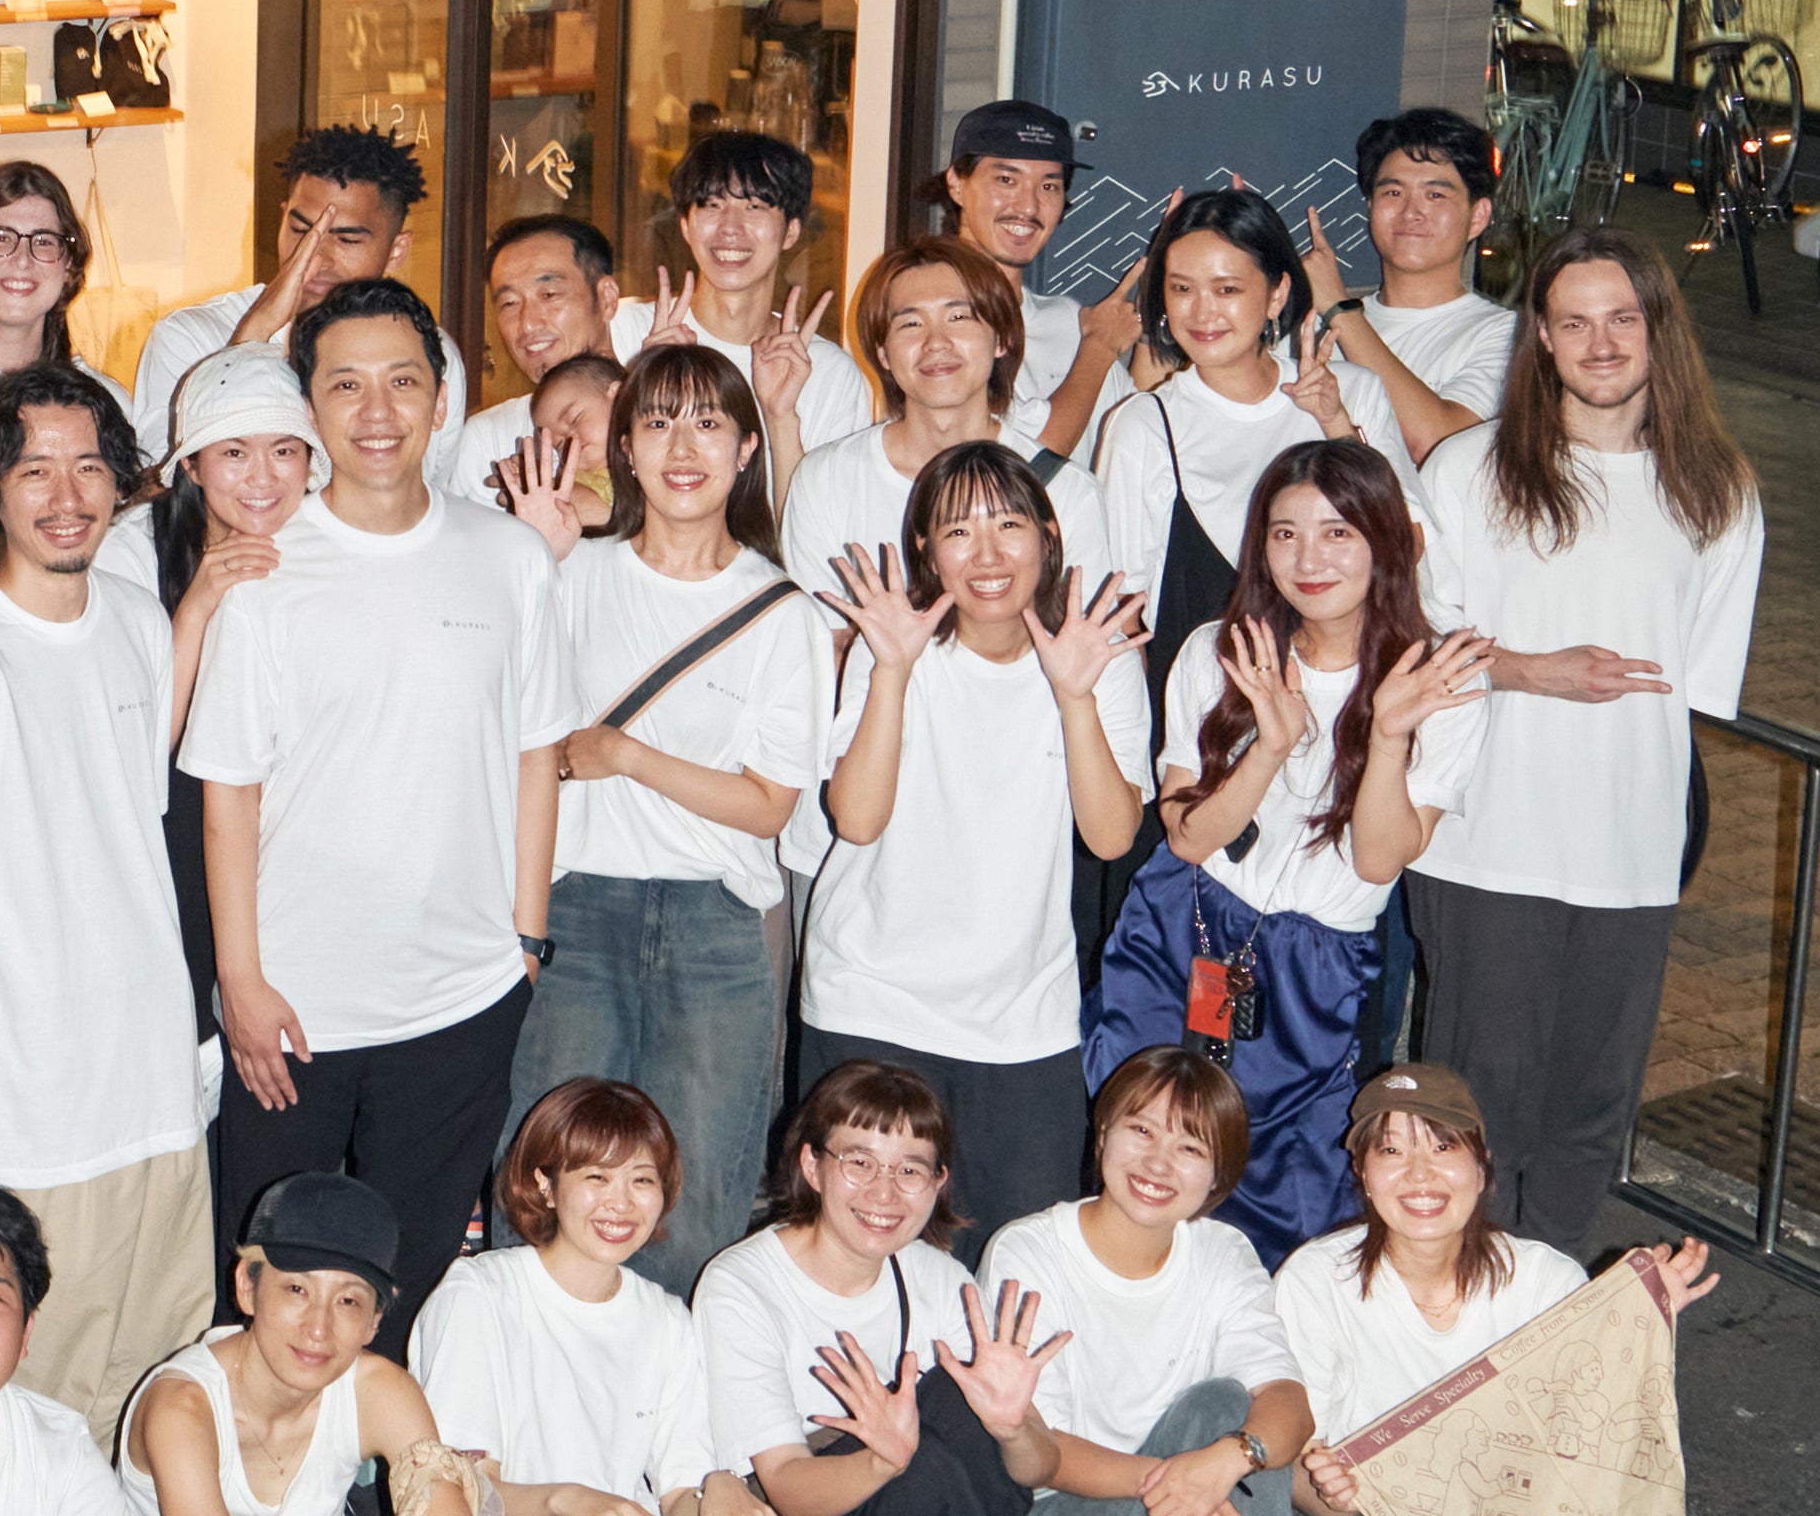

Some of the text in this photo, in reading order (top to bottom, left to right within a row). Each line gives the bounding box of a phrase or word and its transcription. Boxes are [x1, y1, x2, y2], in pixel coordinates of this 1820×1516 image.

[1188, 65, 1322, 93] KURASU
[1370, 1427, 1393, 1446] We
[1399, 1404, 1432, 1428] Serve
[1434, 1367, 1486, 1405] Specialty
[1499, 1333, 1537, 1361] Coffee
[1540, 1314, 1567, 1337] from
